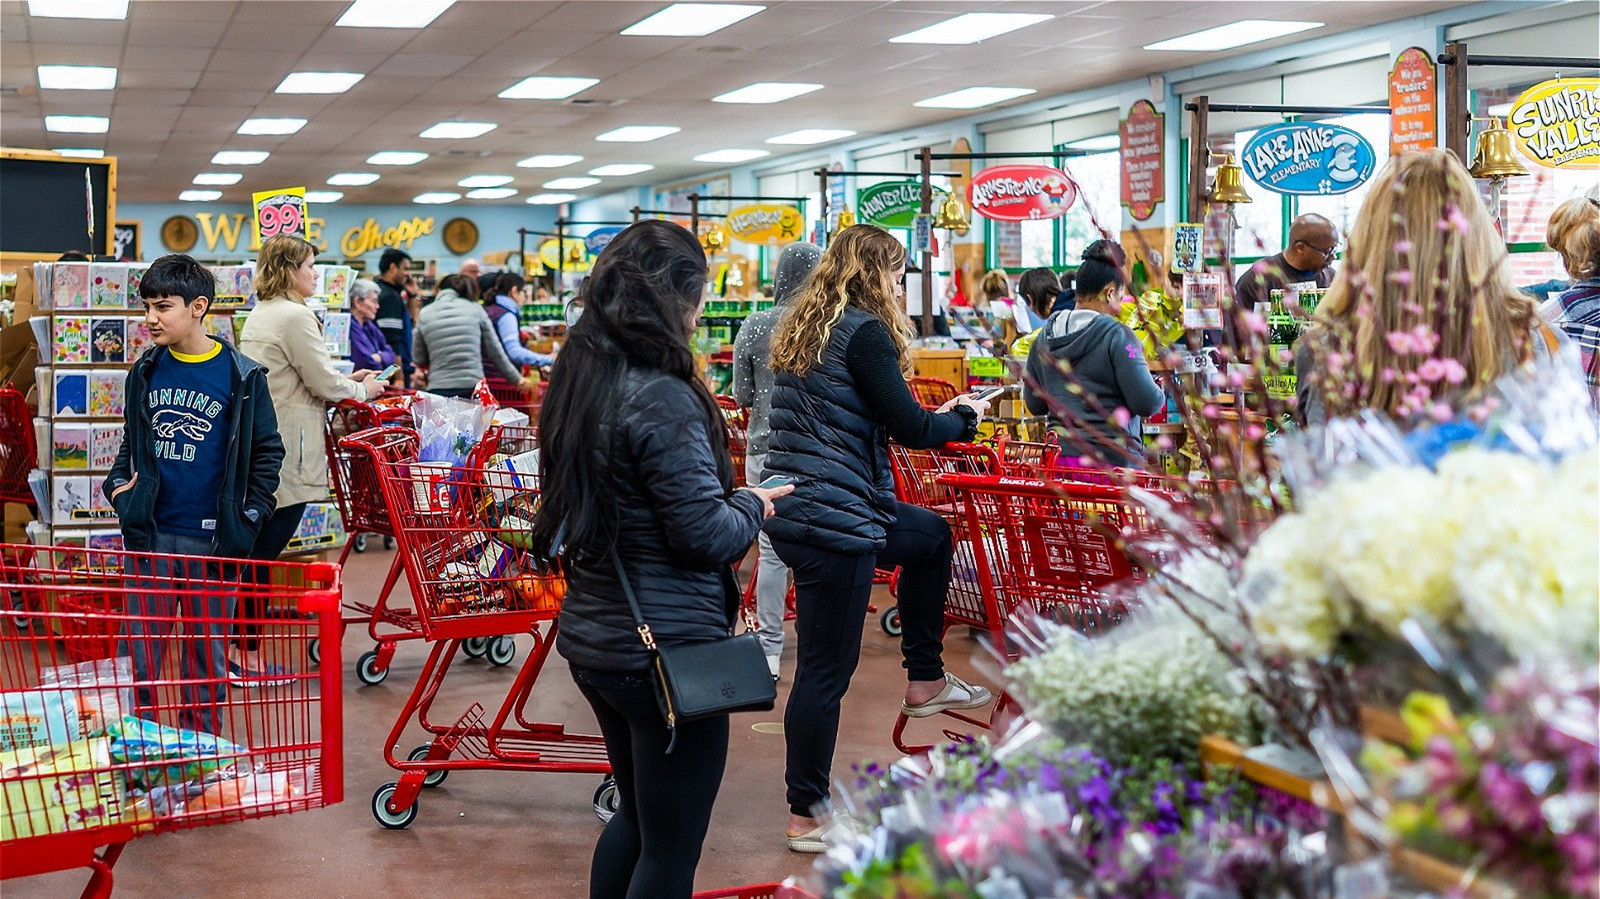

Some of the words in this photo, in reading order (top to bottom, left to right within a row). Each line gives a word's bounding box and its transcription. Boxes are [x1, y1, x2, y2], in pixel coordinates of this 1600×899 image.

[1512, 86, 1600, 138] SUNRIS
[1244, 134, 1293, 180] LAKE
[1291, 127, 1335, 163] ANNE
[1526, 117, 1600, 160] VALLE
[1555, 146, 1600, 166] ELEMENTA
[1270, 158, 1322, 184] ELEMENTARY
[971, 177, 1043, 209] ARMSTRONG
[341, 216, 435, 258] Shoppe
[149, 388, 222, 418] UNNING
